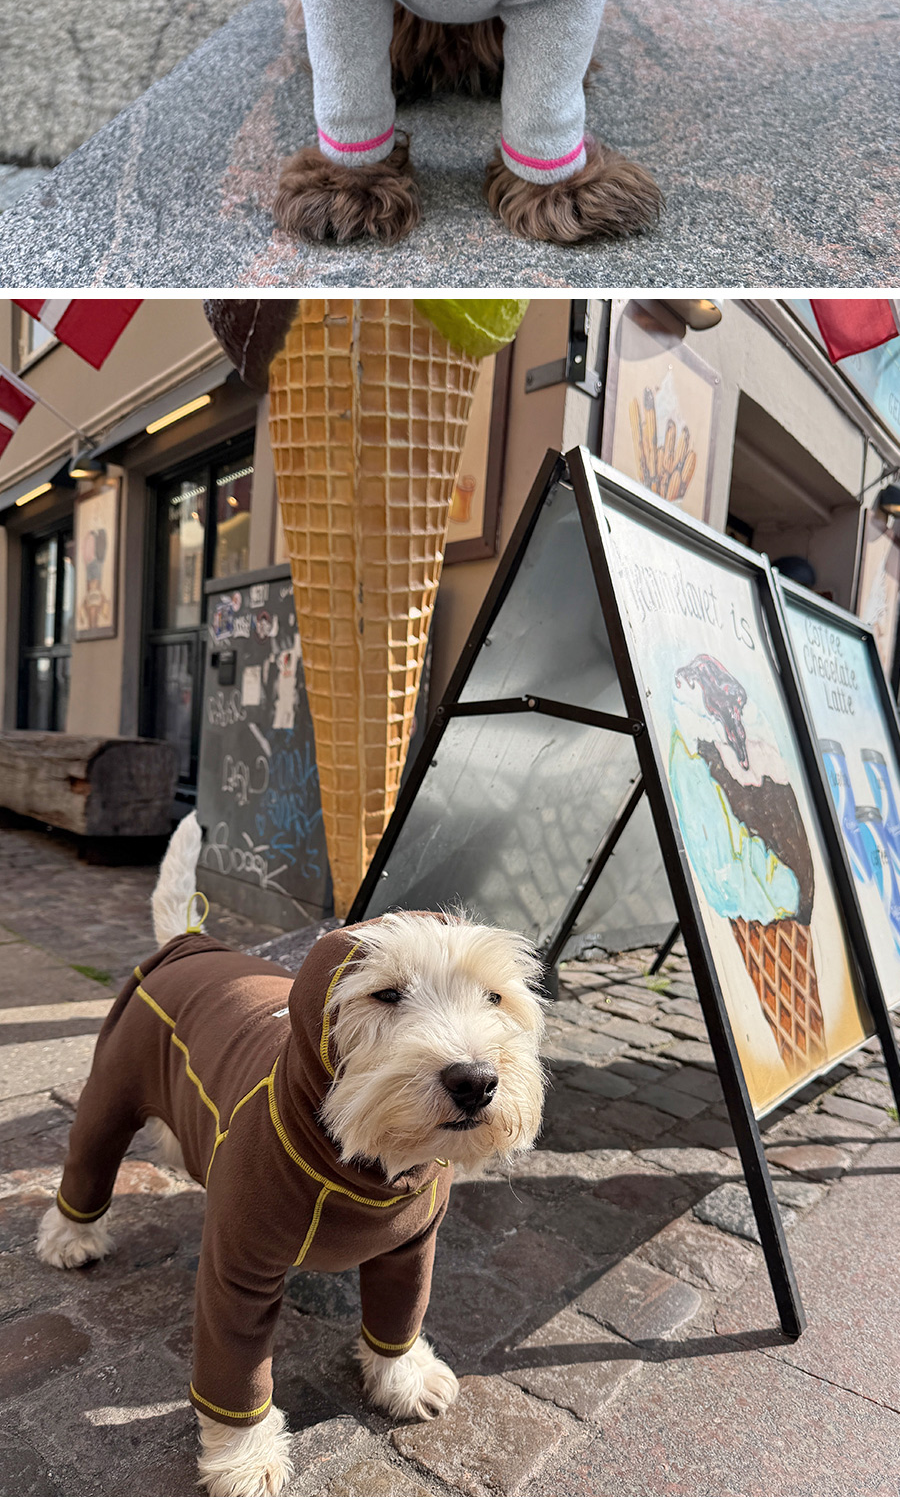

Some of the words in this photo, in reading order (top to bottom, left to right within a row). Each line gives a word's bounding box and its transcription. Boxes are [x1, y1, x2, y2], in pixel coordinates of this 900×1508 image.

[730, 603, 755, 650] is
[805, 617, 843, 657] Coffee
[823, 682, 855, 715] Latte
